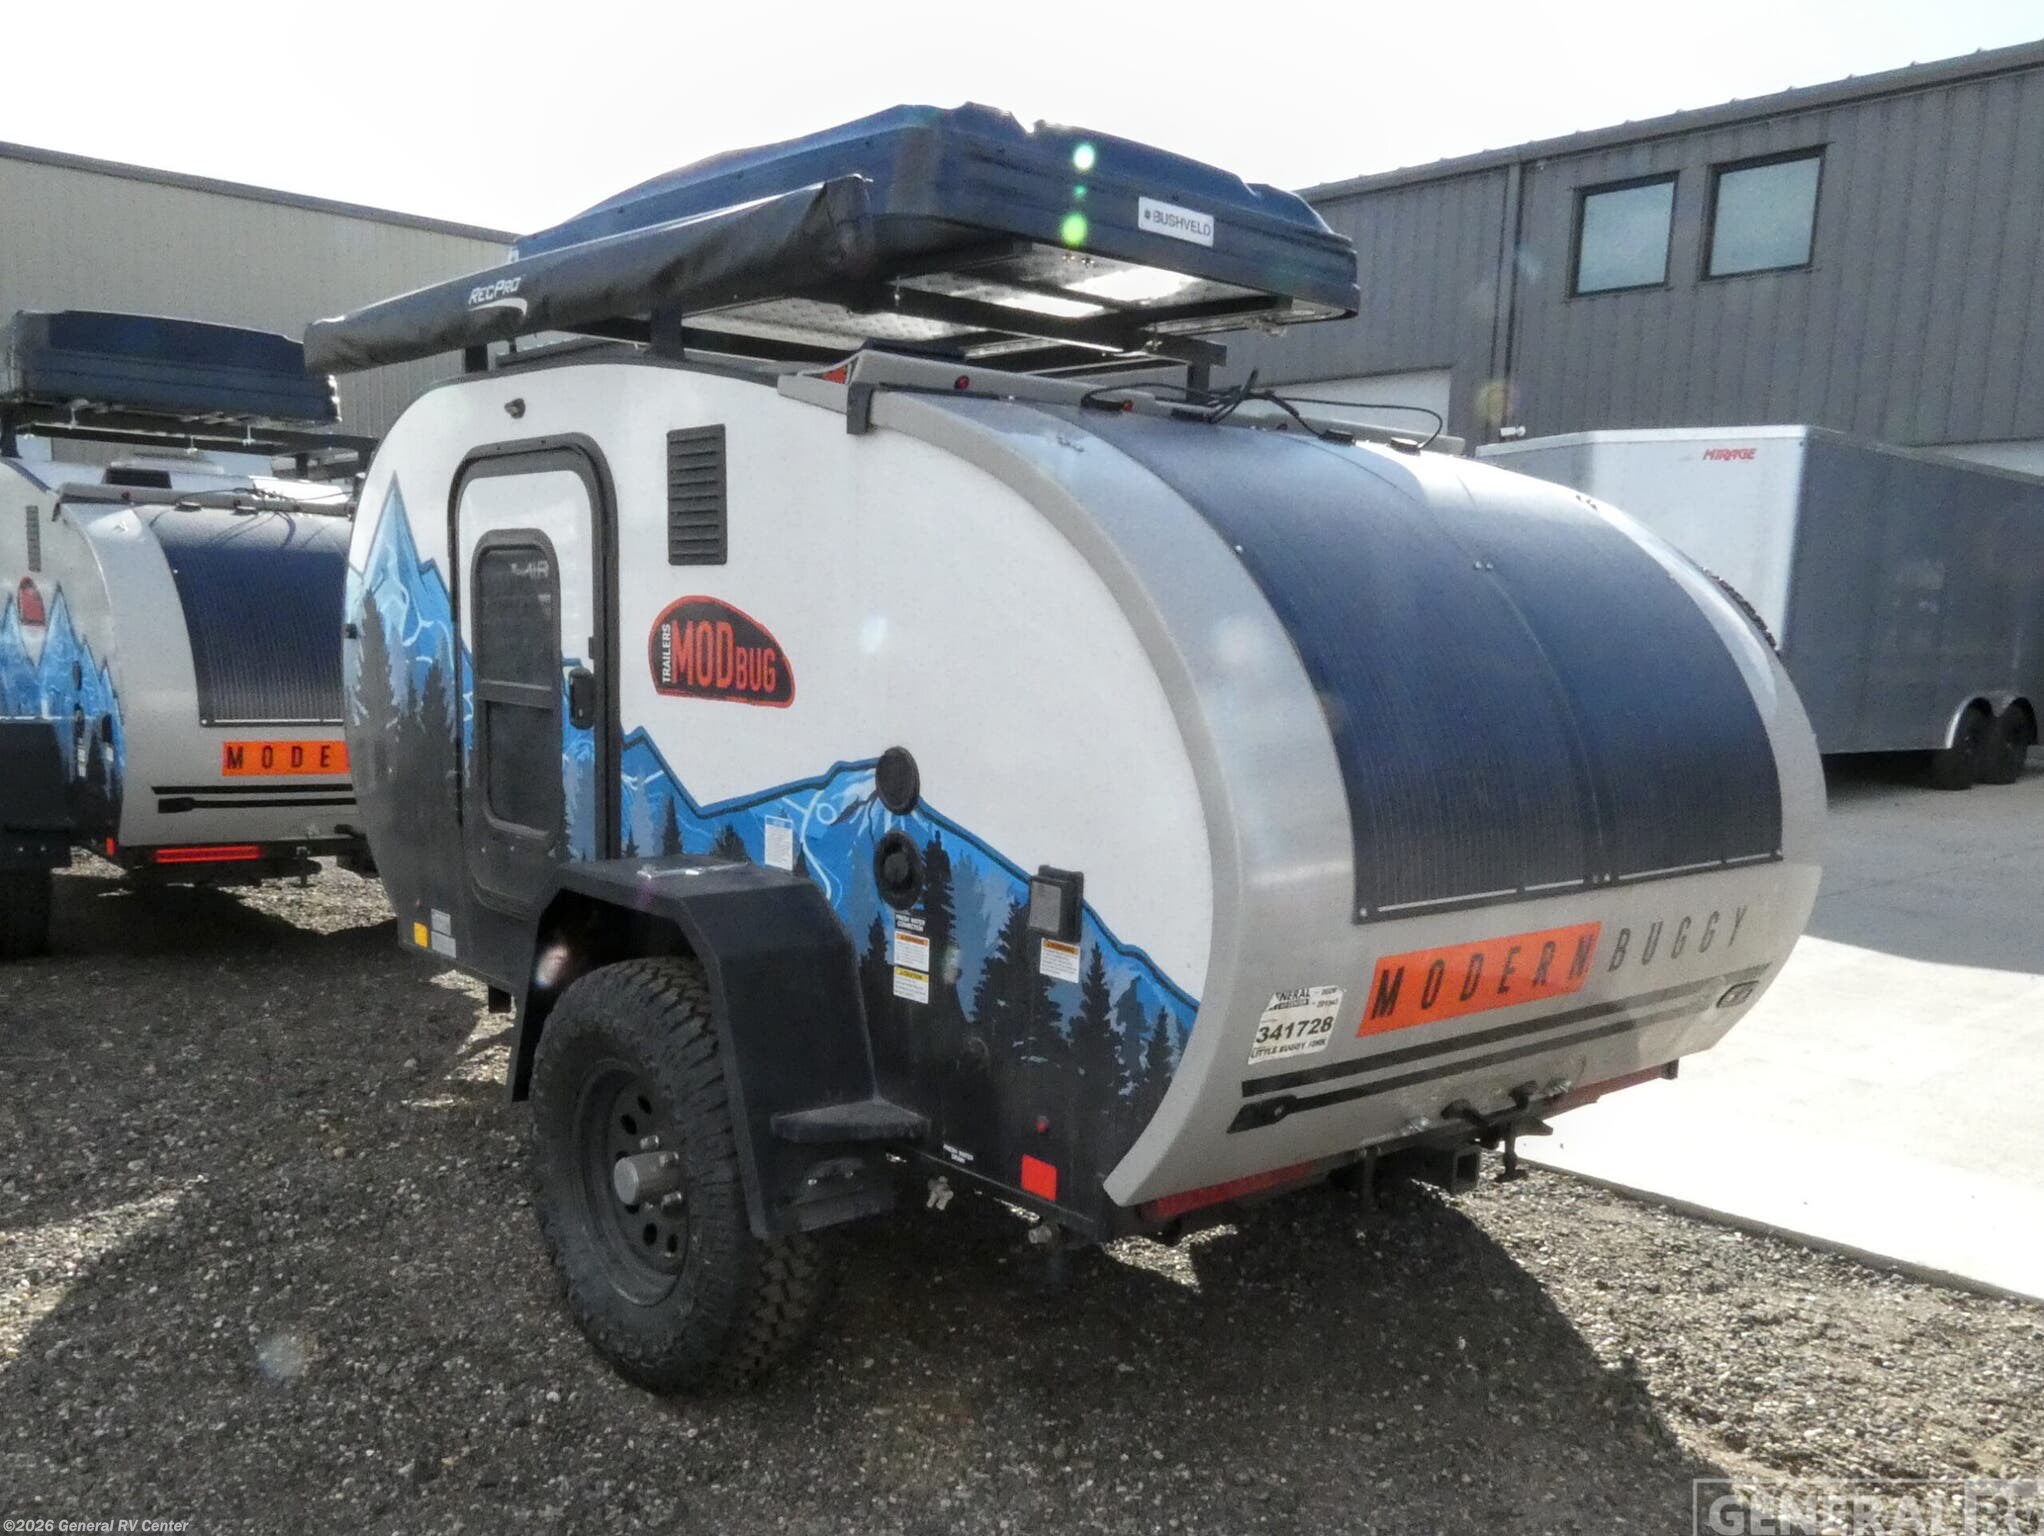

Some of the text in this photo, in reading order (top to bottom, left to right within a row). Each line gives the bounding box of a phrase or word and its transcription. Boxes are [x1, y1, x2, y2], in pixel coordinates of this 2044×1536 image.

[1152, 210, 1212, 237] BUSHVELD
[1702, 447, 1758, 461] MIRAGE
[661, 623, 671, 684] TRAILERS
[226, 744, 331, 769] MODE
[1370, 905, 1749, 1021] MODERN BUGGY
[1255, 1016, 1335, 1044] 341728
